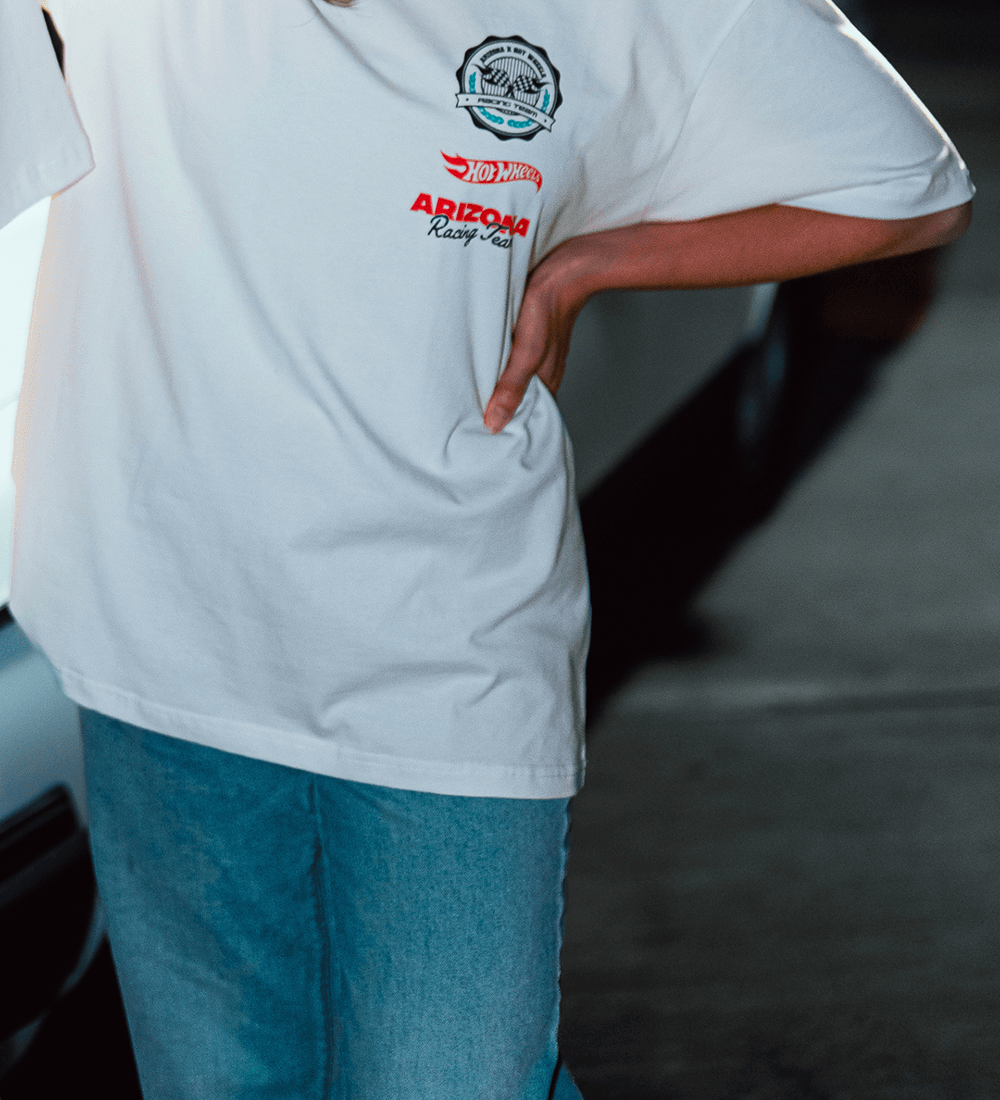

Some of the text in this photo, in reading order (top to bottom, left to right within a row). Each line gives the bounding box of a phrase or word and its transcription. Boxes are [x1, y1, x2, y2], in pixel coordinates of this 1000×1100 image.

[513, 47, 527, 57] HOT
[410, 193, 530, 238] ARIZONA
[427, 214, 514, 249] Racing Tea
